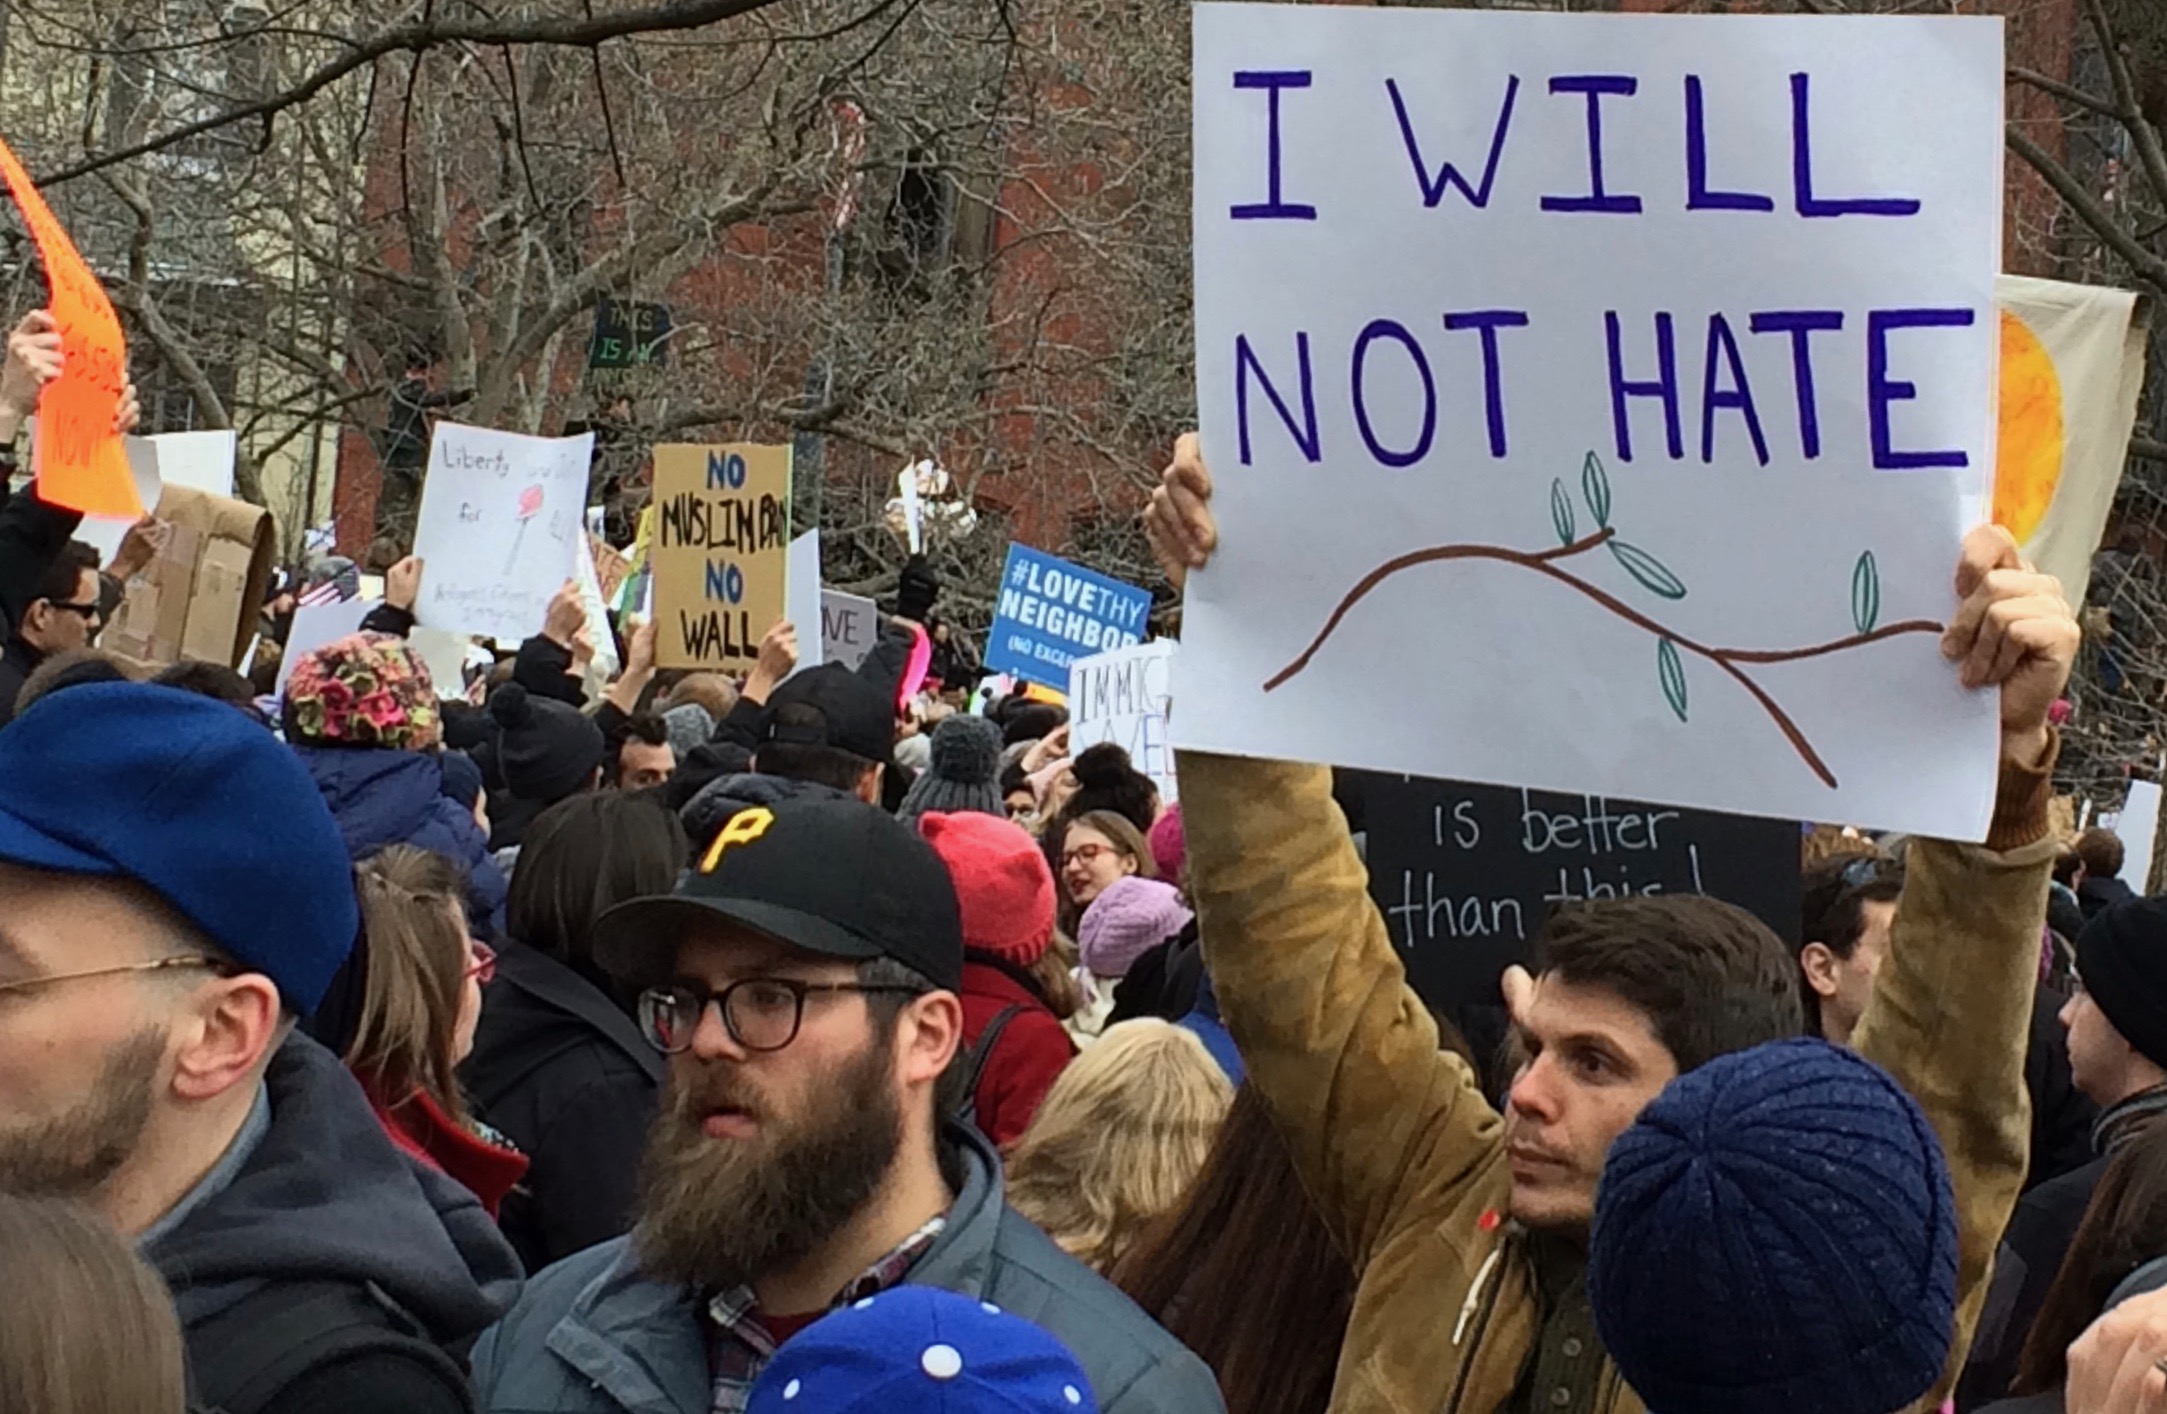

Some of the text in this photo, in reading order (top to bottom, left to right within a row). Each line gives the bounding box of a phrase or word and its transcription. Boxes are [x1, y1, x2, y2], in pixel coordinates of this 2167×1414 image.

[1230, 70, 1921, 220] I WILL
[600, 336, 622, 360] IS
[1234, 308, 1975, 470] NOT HATE
[441, 438, 510, 479] Liberty
[706, 450, 746, 490] NO
[705, 558, 744, 605] NO
[681, 608, 759, 661] WALL
[699, 806, 775, 874] P
[1520, 785, 1680, 855] better
[1389, 869, 1525, 948] than
